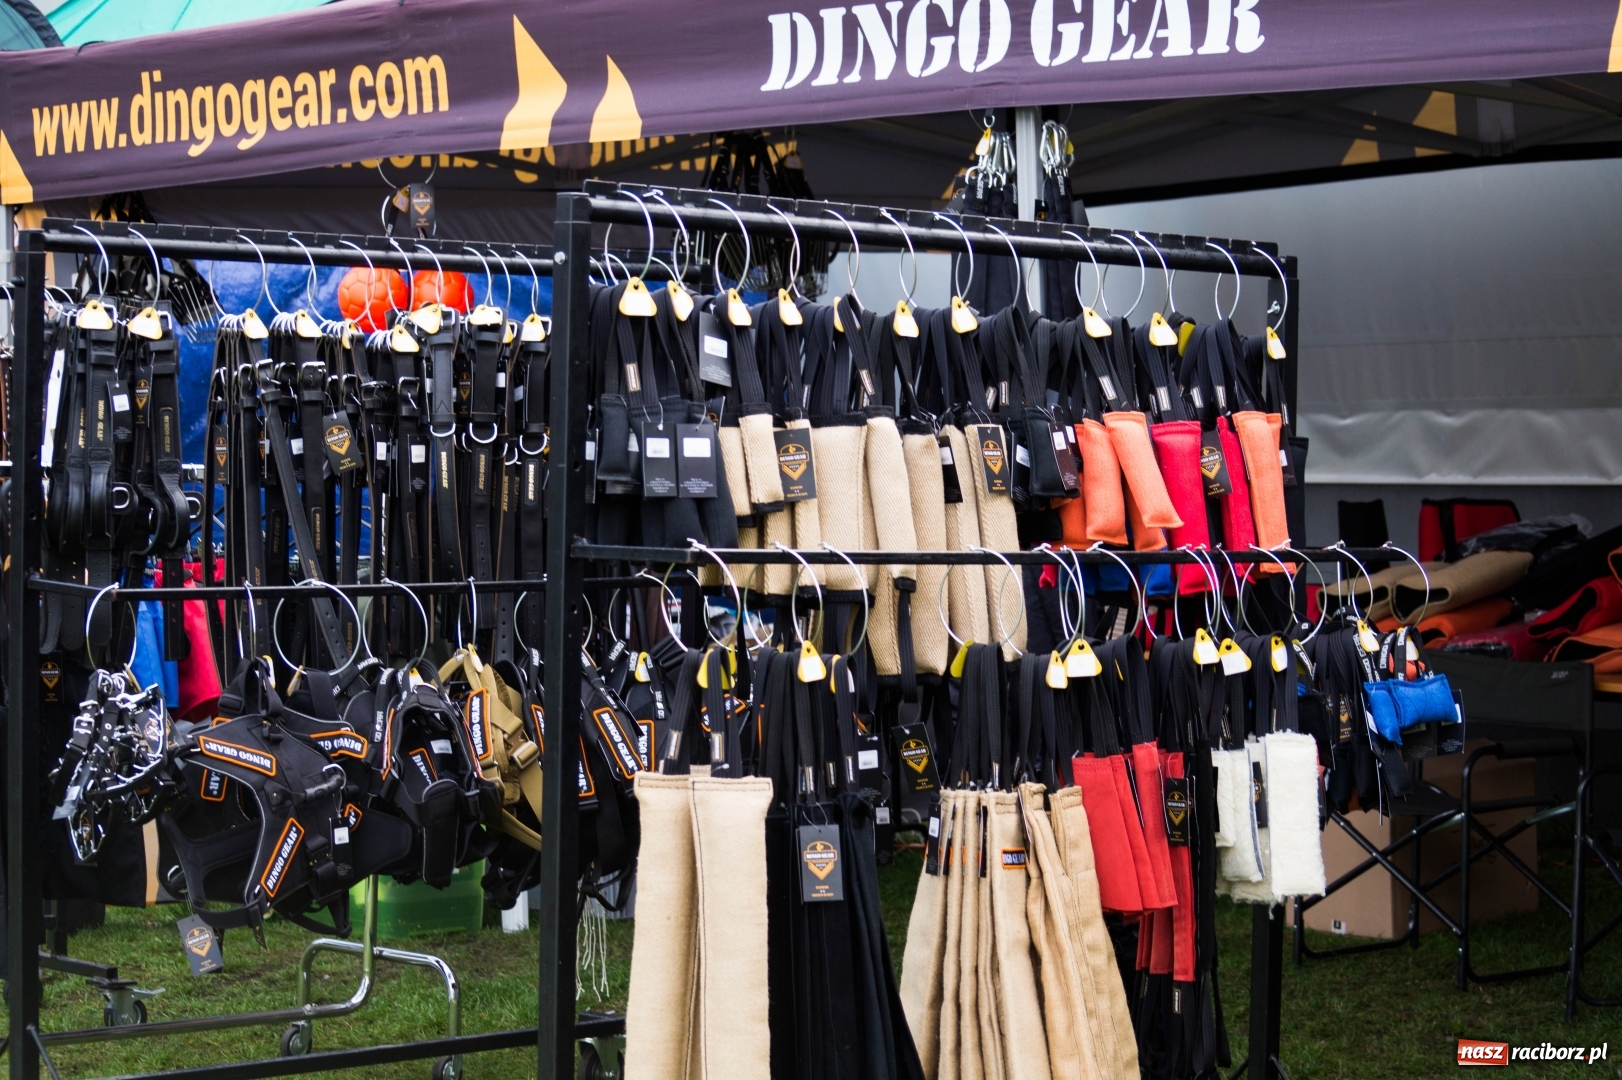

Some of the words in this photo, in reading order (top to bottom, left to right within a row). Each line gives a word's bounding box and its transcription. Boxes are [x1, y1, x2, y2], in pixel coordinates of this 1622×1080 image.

[760, 0, 1012, 92] DINGO
[1031, 0, 1266, 68] GEAR
[32, 54, 449, 157] www.dingogear.com
[600, 713, 623, 746] DINGO
[239, 750, 272, 769] DINGO
[266, 856, 285, 890] DINGO
